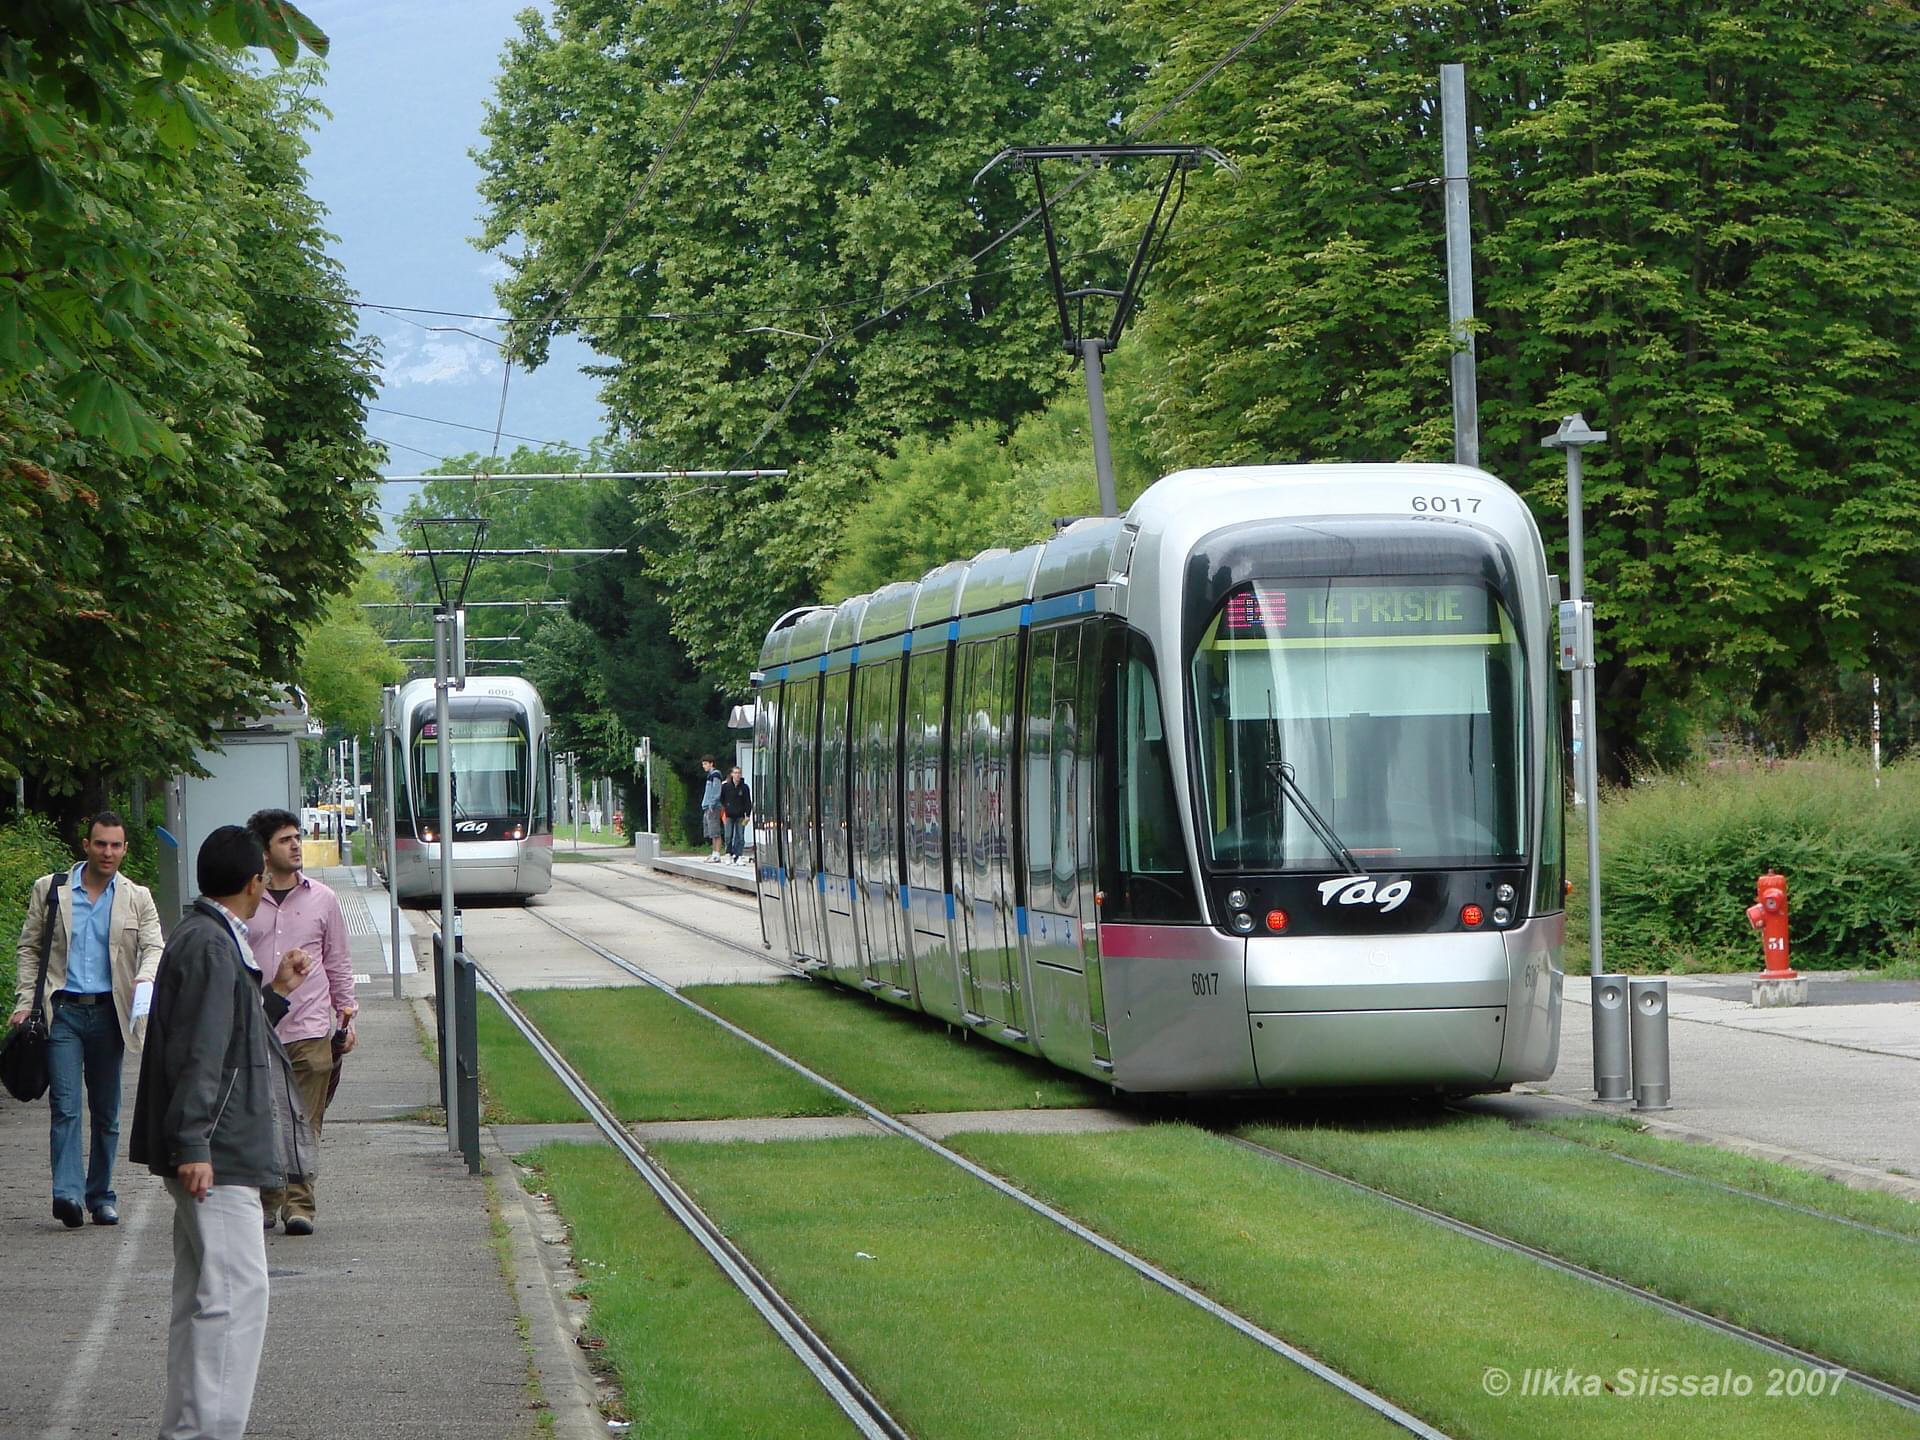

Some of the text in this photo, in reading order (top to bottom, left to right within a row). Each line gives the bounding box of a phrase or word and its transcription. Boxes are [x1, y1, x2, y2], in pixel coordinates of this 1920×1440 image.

[1411, 495, 1483, 514] 6017
[1307, 592, 1345, 625] LE
[1351, 590, 1464, 624] PRISME
[1191, 972, 1219, 996] 6017
